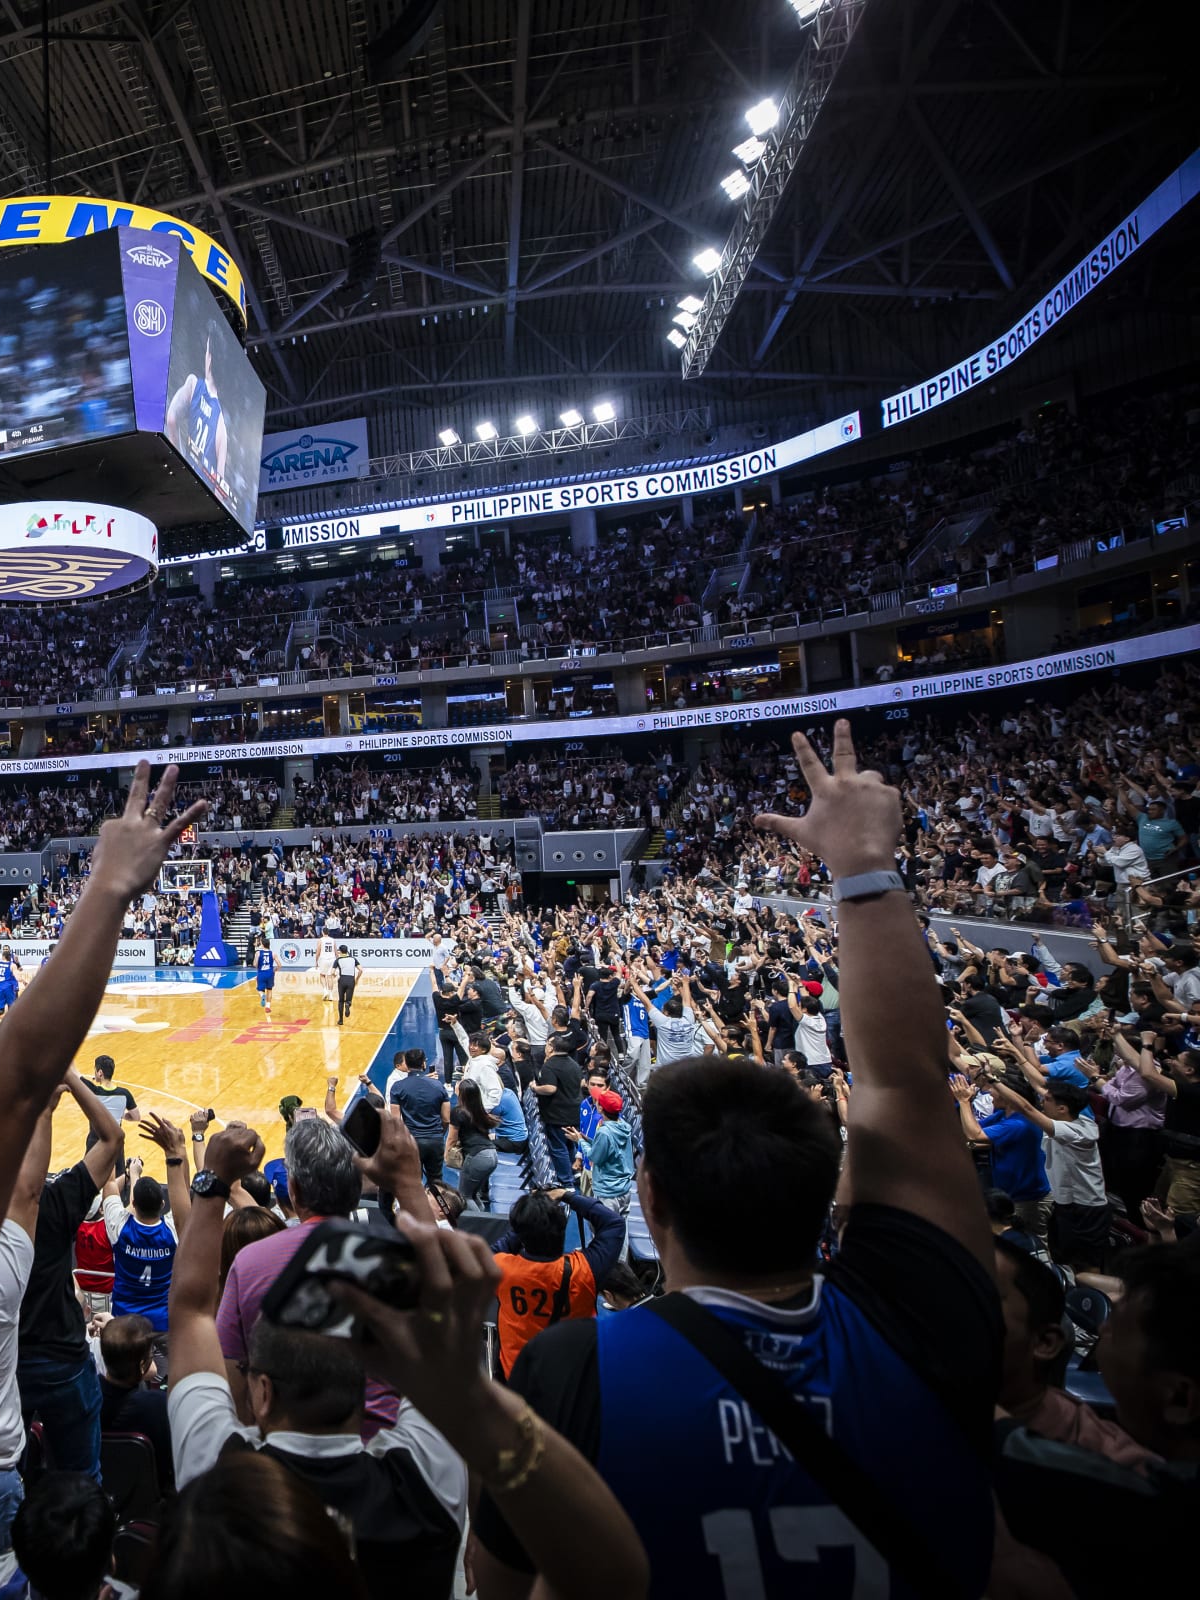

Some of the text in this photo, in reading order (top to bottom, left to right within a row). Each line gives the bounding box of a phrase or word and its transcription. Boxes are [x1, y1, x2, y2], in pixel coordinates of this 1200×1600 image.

[132, 253, 166, 269] ARENA
[887, 215, 1140, 424] HILIPPINE SPORTS COMMISSION
[268, 446, 349, 476] ARENA
[268, 465, 349, 485] MALL OF ASIA
[452, 448, 777, 523] PHILIPPINE SPORTS COMMISSION
[254, 519, 360, 549] CMMISSION
[560, 660, 581, 670] 402
[912, 650, 1116, 698] PHILIPPINE SPORTS COMMISSION
[57, 706, 72, 714] 421
[653, 698, 837, 729] PHILIPPINE SPORTS COMMISSION
[885, 708, 910, 721] 203
[359, 730, 512, 750] PHILIPPINE SPORTS COMMISSION
[565, 742, 584, 752] 202
[168, 744, 303, 762] PHILIPPINE SPORTS COMMISSION
[385, 754, 401, 763] 201
[24, 759, 70, 771] COMMISSION
[181, 831, 196, 843] 24
[373, 829, 389, 838] 101
[11, 949, 51, 957] HILIPPINE
[115, 949, 146, 957] ISSION
[360, 948, 403, 957] SPORTS
[125, 1244, 171, 1259] RAYMUNDO
[138, 1264, 153, 1287] 4
